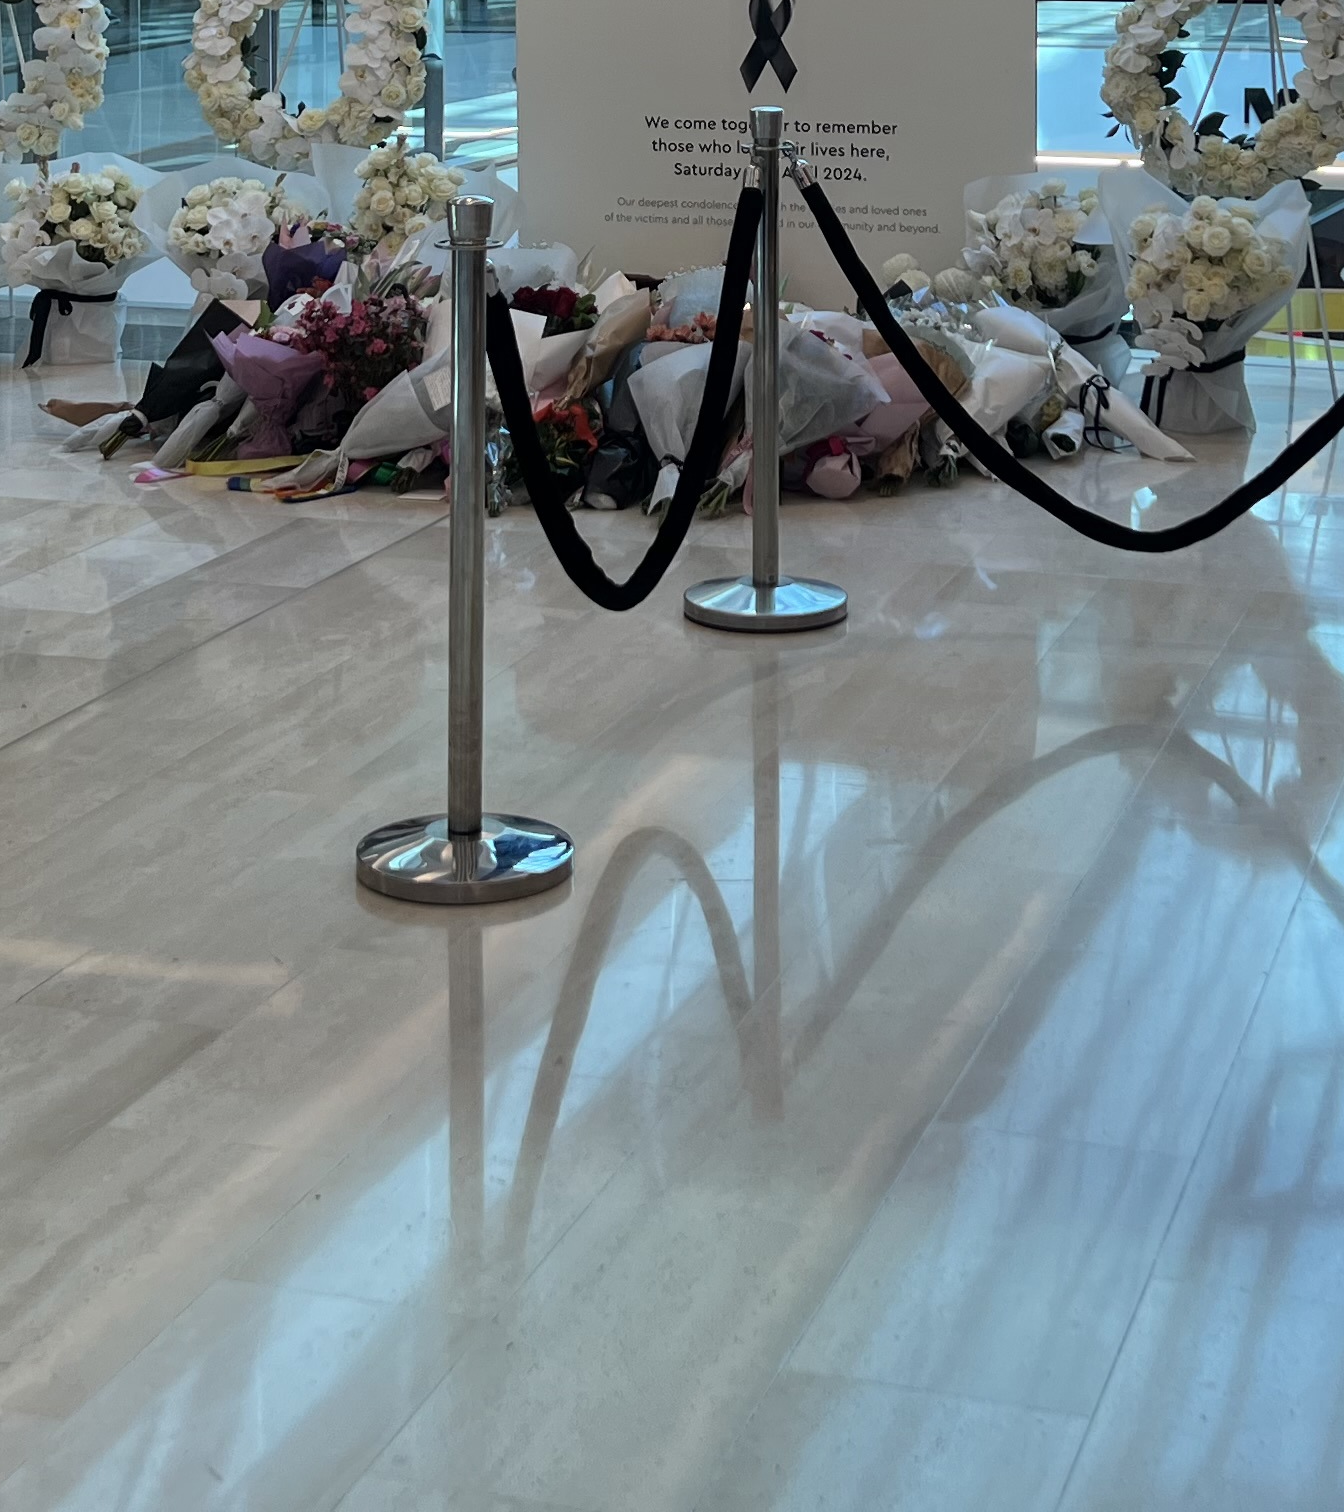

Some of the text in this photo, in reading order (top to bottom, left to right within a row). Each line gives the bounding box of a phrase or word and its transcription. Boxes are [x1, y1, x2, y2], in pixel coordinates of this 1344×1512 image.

[644, 116, 669, 130] We
[674, 118, 716, 130] come
[795, 120, 810, 133] to
[816, 120, 898, 135] remember
[652, 138, 694, 152] those
[699, 139, 732, 153] who
[811, 142, 845, 157] lives
[851, 143, 890, 161] here,
[674, 163, 741, 180] Saturday
[824, 168, 867, 181] 2024.
[617, 197, 635, 206] Our
[638, 198, 678, 209] deepest
[790, 203, 805, 212] the
[849, 205, 868, 215] and
[871, 206, 899, 216] loved
[902, 208, 927, 217] ones
[604, 212, 614, 222] of
[616, 213, 632, 222] the
[634, 214, 668, 224] victims
[672, 215, 689, 225] and
[692, 216, 703, 225] all
[706, 217, 733, 226] those
[787, 219, 795, 228] in
[877, 222, 896, 232] and
